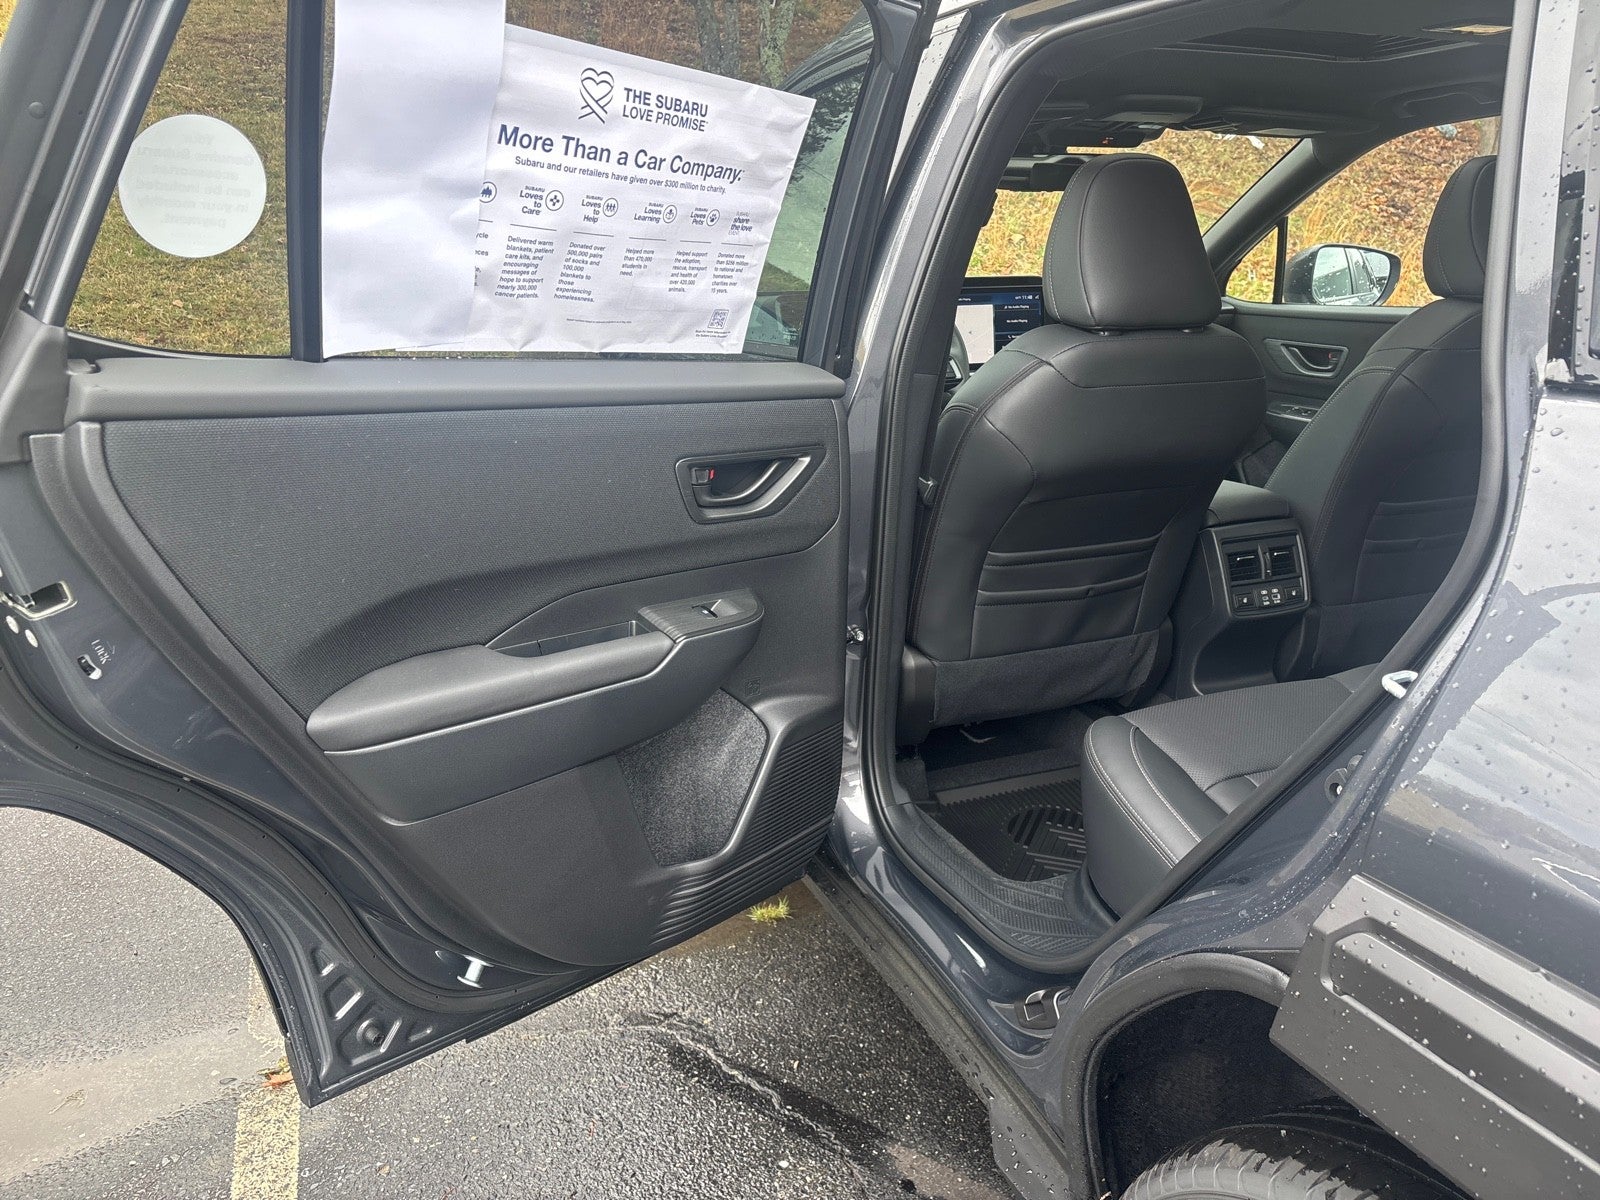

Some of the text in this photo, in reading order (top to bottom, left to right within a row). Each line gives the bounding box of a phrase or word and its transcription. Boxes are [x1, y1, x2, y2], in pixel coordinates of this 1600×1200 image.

[623, 87, 708, 118] THE SUBARU
[622, 105, 653, 122] LOVE
[498, 124, 554, 153] More
[561, 135, 611, 163] Than
[617, 150, 629, 167] a
[634, 149, 666, 172] Car
[515, 156, 545, 168] Subaru
[546, 162, 562, 171] and
[563, 165, 577, 174] our
[578, 167, 609, 179] retailers
[610, 172, 628, 182] have
[629, 175, 648, 184] given
[649, 178, 664, 186] over
[664, 179, 679, 188] $300
[679, 181, 699, 190] million
[706, 185, 727, 195] charity.
[520, 190, 544, 200] Loves
[581, 199, 601, 208] Loves
[521, 206, 541, 215] Care
[644, 207, 662, 215] Loves
[583, 214, 599, 223] Help
[634, 213, 661, 224] Learning
[733, 217, 750, 225] share
[508, 235, 536, 245] Delivered
[506, 245, 533, 253] blankets,
[569, 242, 592, 250] Donated
[567, 250, 588, 258] 500,000
[625, 248, 642, 256] Helped
[503, 261, 539, 269] encouraging
[499, 276, 514, 284] hope
[497, 284, 516, 292] nearly
[556, 286, 592, 296] experiencing
[554, 293, 594, 302] homelessness.
[91, 639, 111, 664] LOCK
